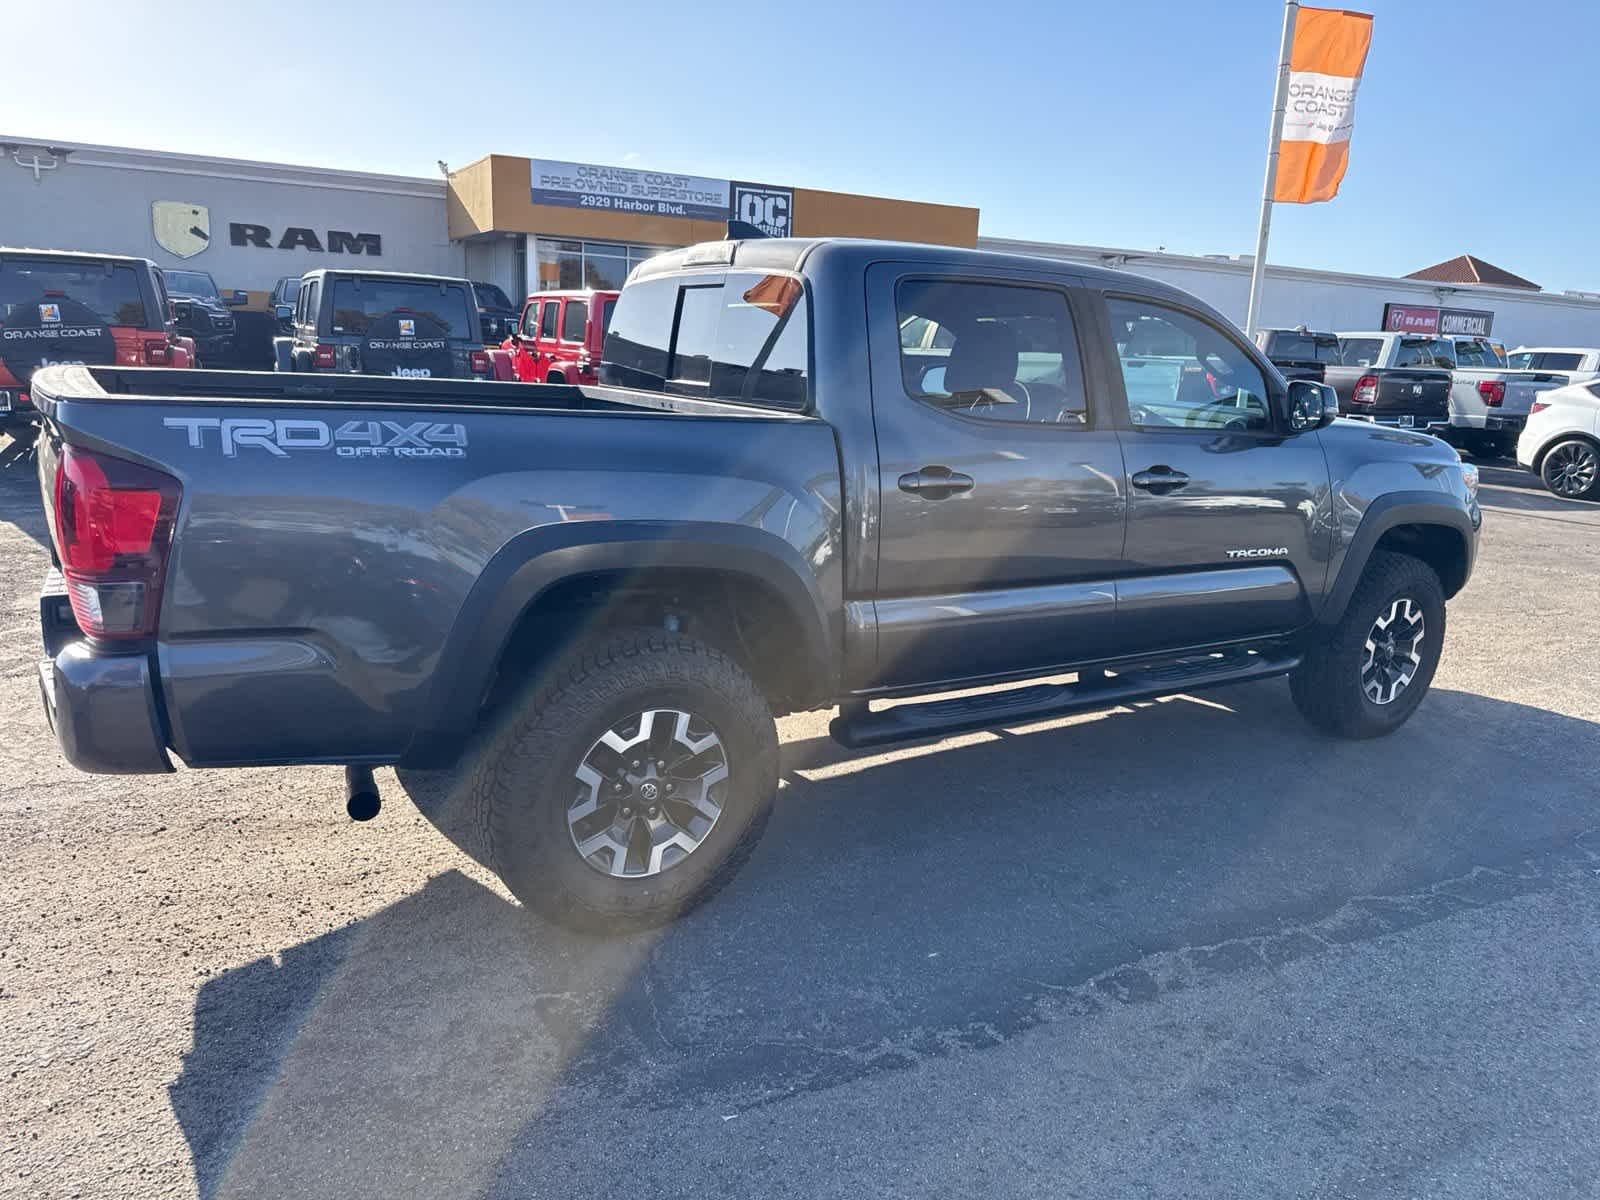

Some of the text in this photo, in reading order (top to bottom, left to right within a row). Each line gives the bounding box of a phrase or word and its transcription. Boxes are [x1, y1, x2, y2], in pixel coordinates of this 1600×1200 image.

[1289, 84, 1356, 103] ORANGE
[1294, 100, 1349, 117] COAST
[577, 166, 690, 189] ORANGE COAST
[540, 175, 722, 205] PRE-OWNED SUPERSTORE
[580, 194, 687, 216] 2929 Harbor Blvd.
[741, 193, 787, 228] OC
[229, 222, 381, 256] RAM
[1405, 315, 1436, 327] RAM
[1441, 315, 1487, 335] COMMERCIAL
[3, 328, 102, 340] ORANGE COAST
[369, 341, 445, 349] ORANGE COAST
[391, 365, 432, 379] Jeep
[163, 417, 334, 458] TRD
[336, 446, 467, 458] OFF ROAD
[1226, 547, 1288, 558] TACOMA
